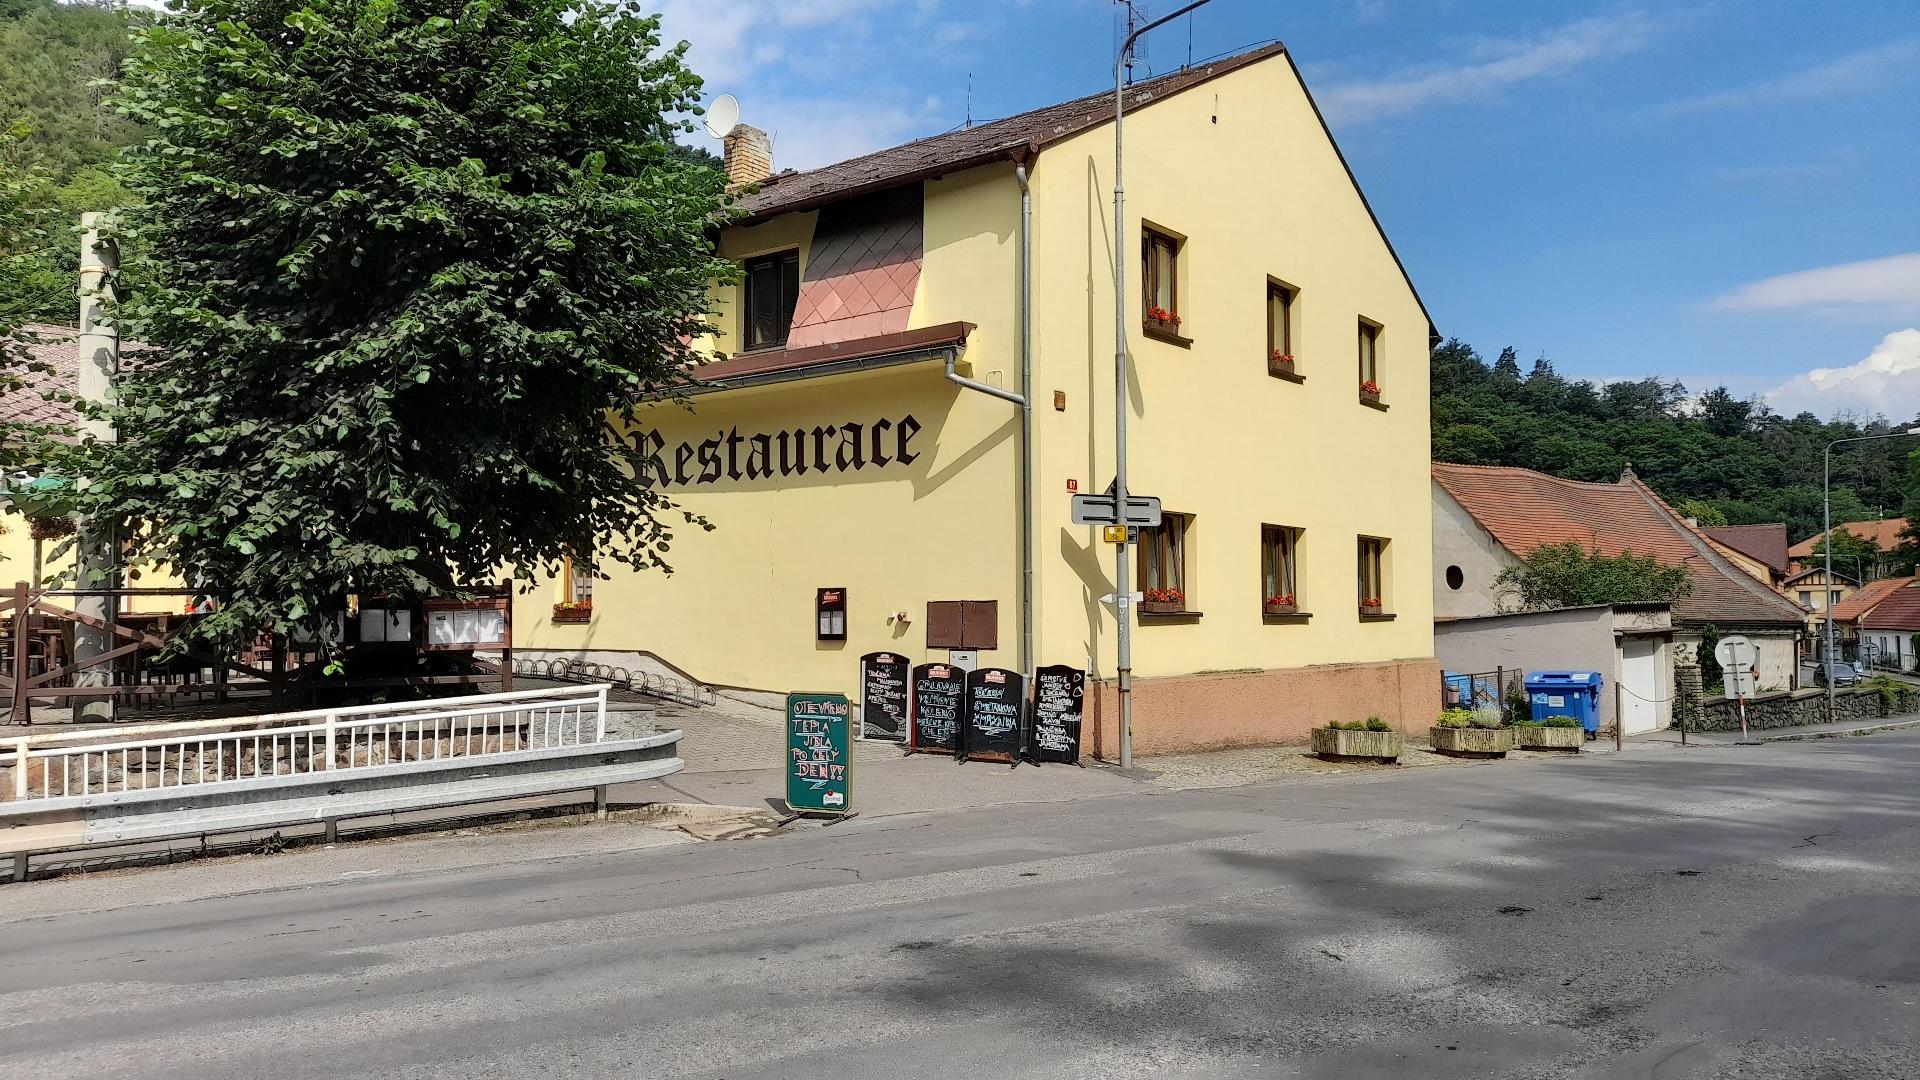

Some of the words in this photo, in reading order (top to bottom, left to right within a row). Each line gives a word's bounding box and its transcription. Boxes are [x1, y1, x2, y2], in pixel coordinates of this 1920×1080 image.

[626, 414, 922, 489] Restaurace
[793, 701, 848, 715] OTEVŘENO
[920, 705, 956, 720] KOLENO
[791, 748, 808, 761] PO
